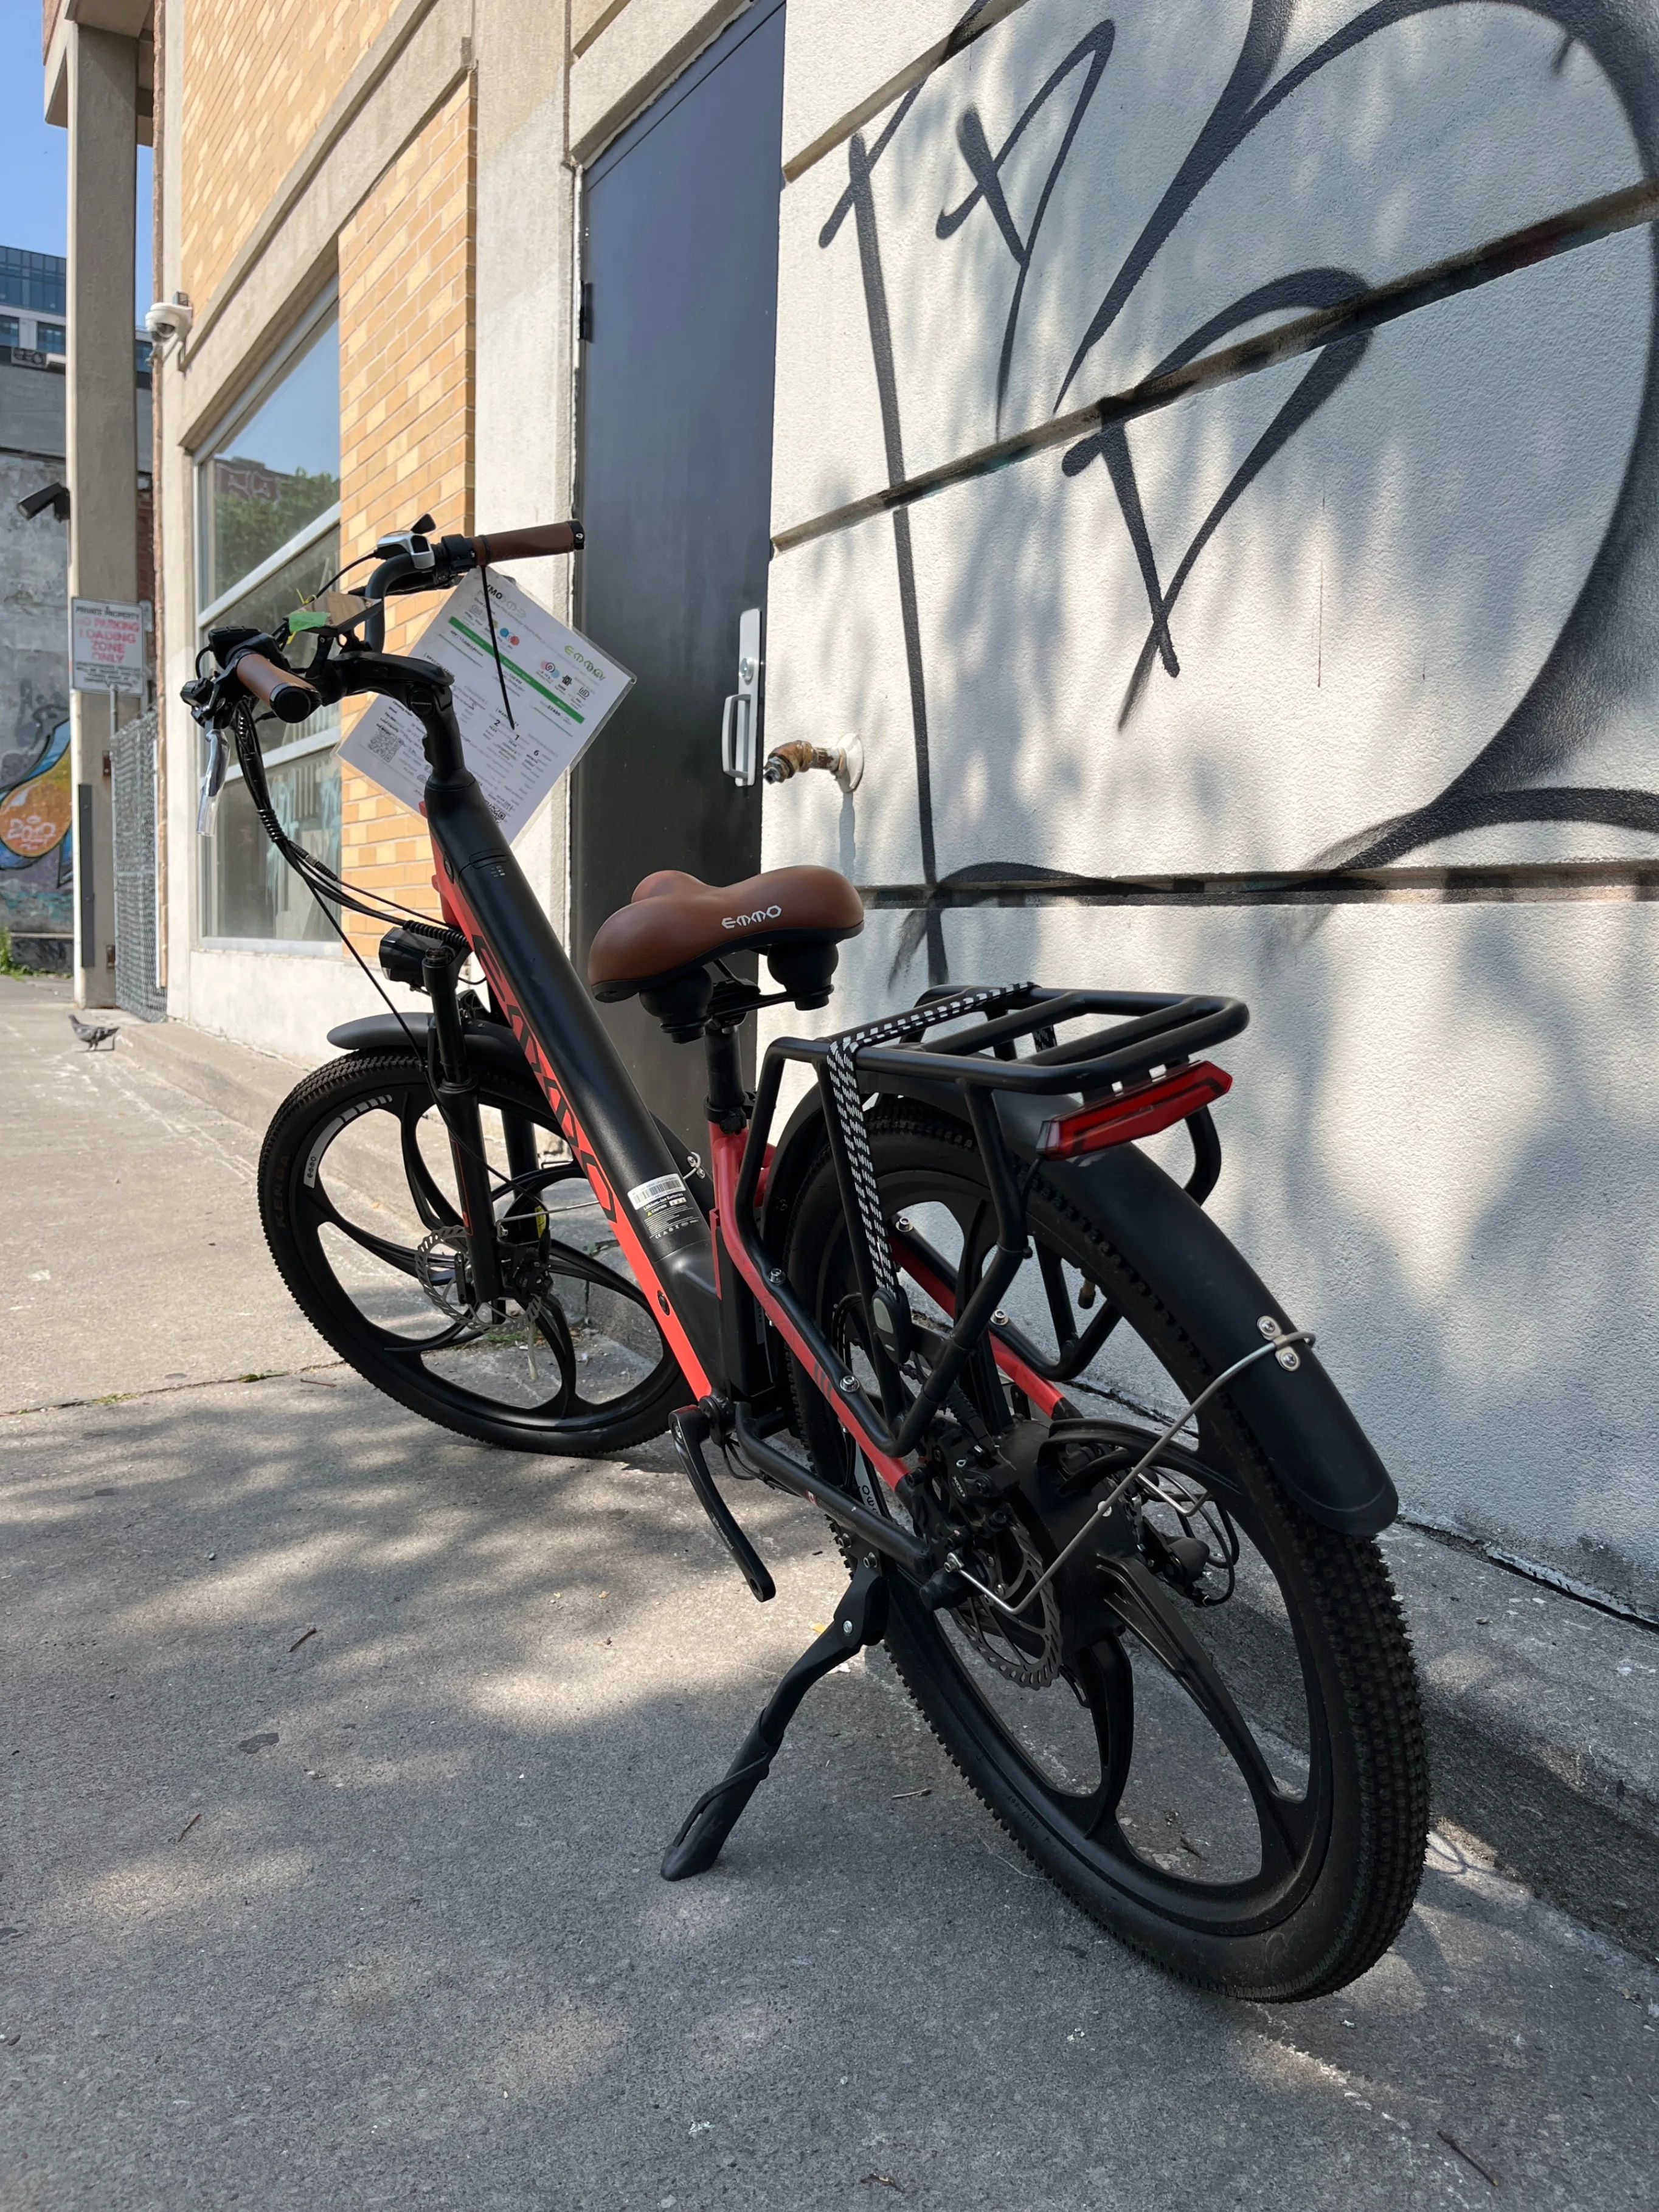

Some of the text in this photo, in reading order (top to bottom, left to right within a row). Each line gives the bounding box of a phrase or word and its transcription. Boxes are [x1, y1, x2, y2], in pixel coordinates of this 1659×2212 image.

[79, 628, 136, 643] LOADING
[91, 640, 125, 653] ZONE
[721, 905, 782, 929] EMMO
